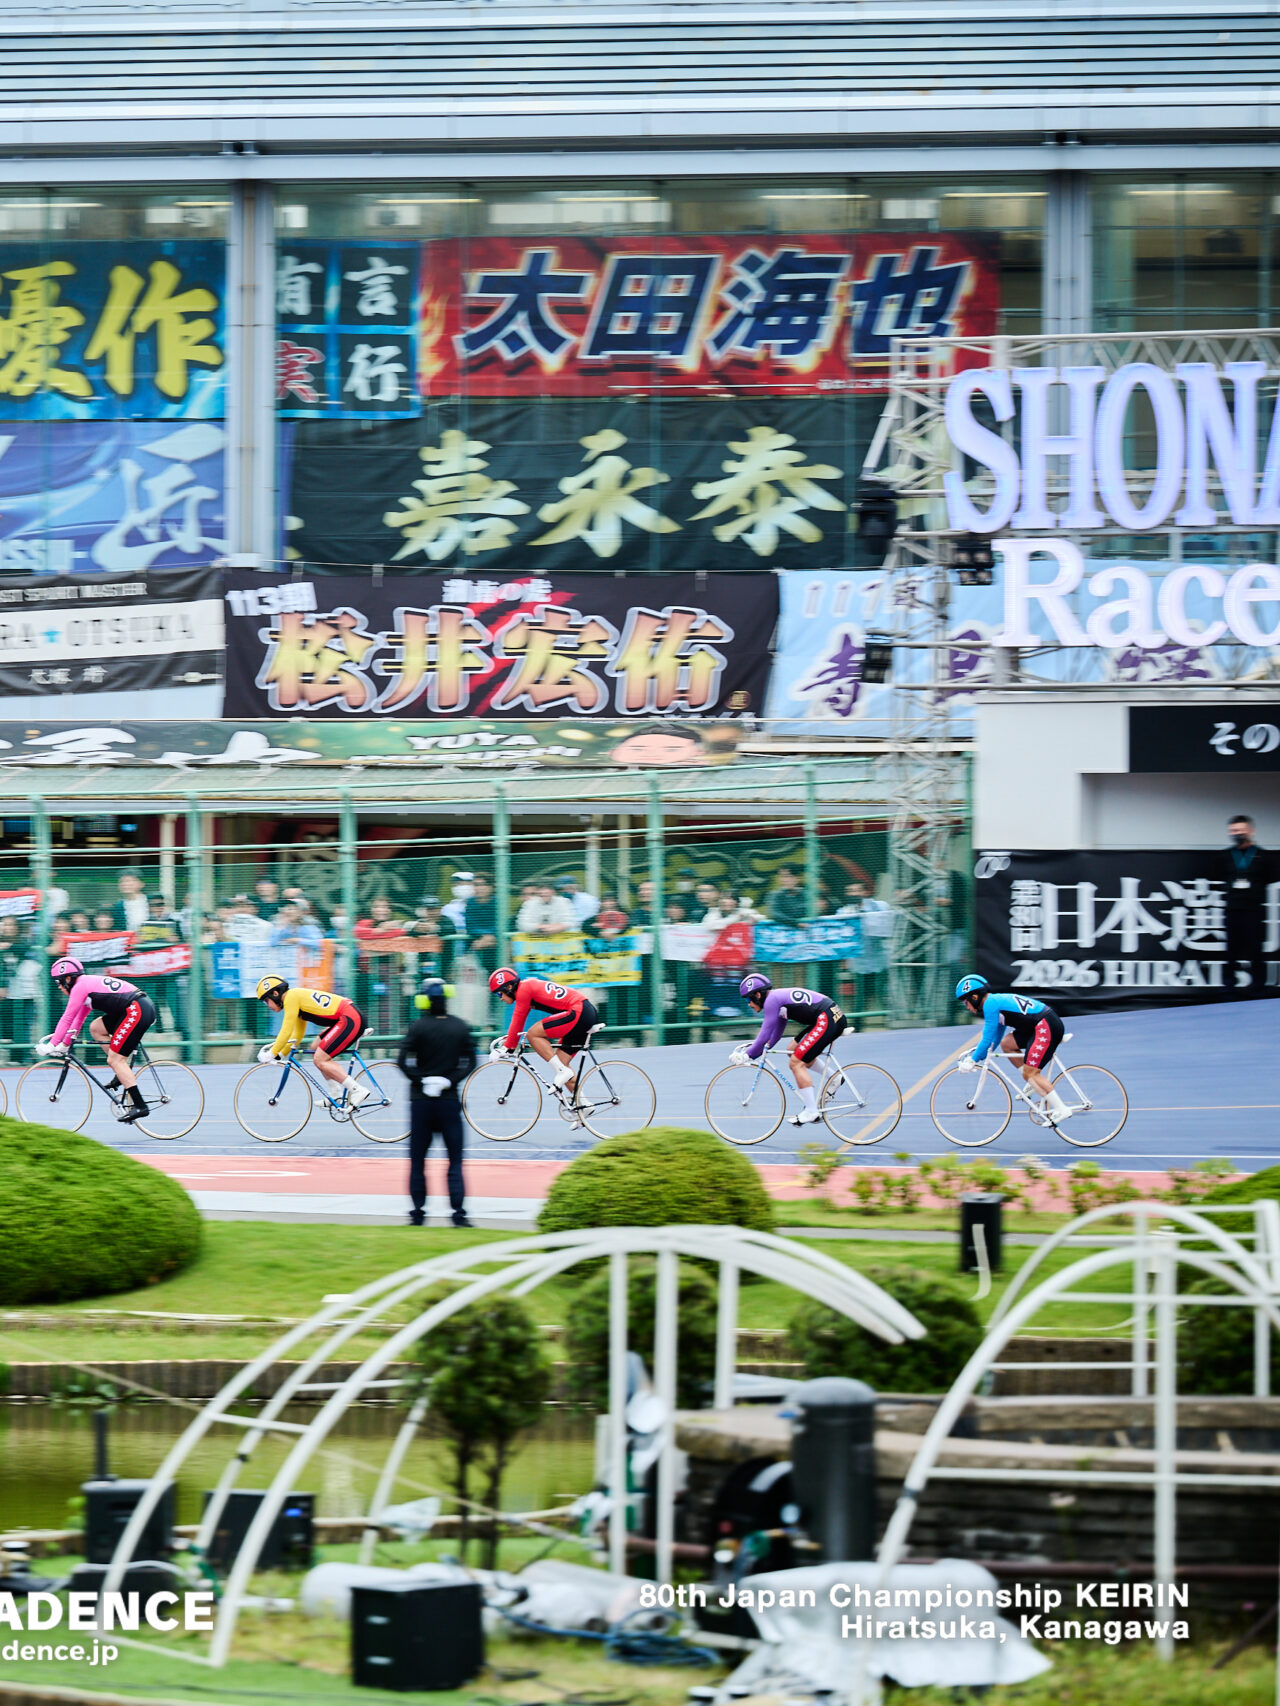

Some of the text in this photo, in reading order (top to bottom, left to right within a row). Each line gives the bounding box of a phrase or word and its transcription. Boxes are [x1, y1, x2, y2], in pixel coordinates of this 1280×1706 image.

[454, 246, 975, 370] 太田海也
[945, 362, 1280, 533] SHON
[992, 538, 1280, 648] Race
[255, 605, 734, 715] 松井宏佑
[1042, 877, 1280, 953] 日本選
[496, 972, 505, 984] 3
[1010, 959, 1100, 987] 2026
[103, 976, 123, 993] 8
[545, 982, 568, 1000] 3
[746, 978, 754, 991] 9
[962, 981, 971, 993] 4
[312, 990, 332, 1008] 5
[790, 989, 812, 1007] 9
[1012, 994, 1035, 1015] 4
